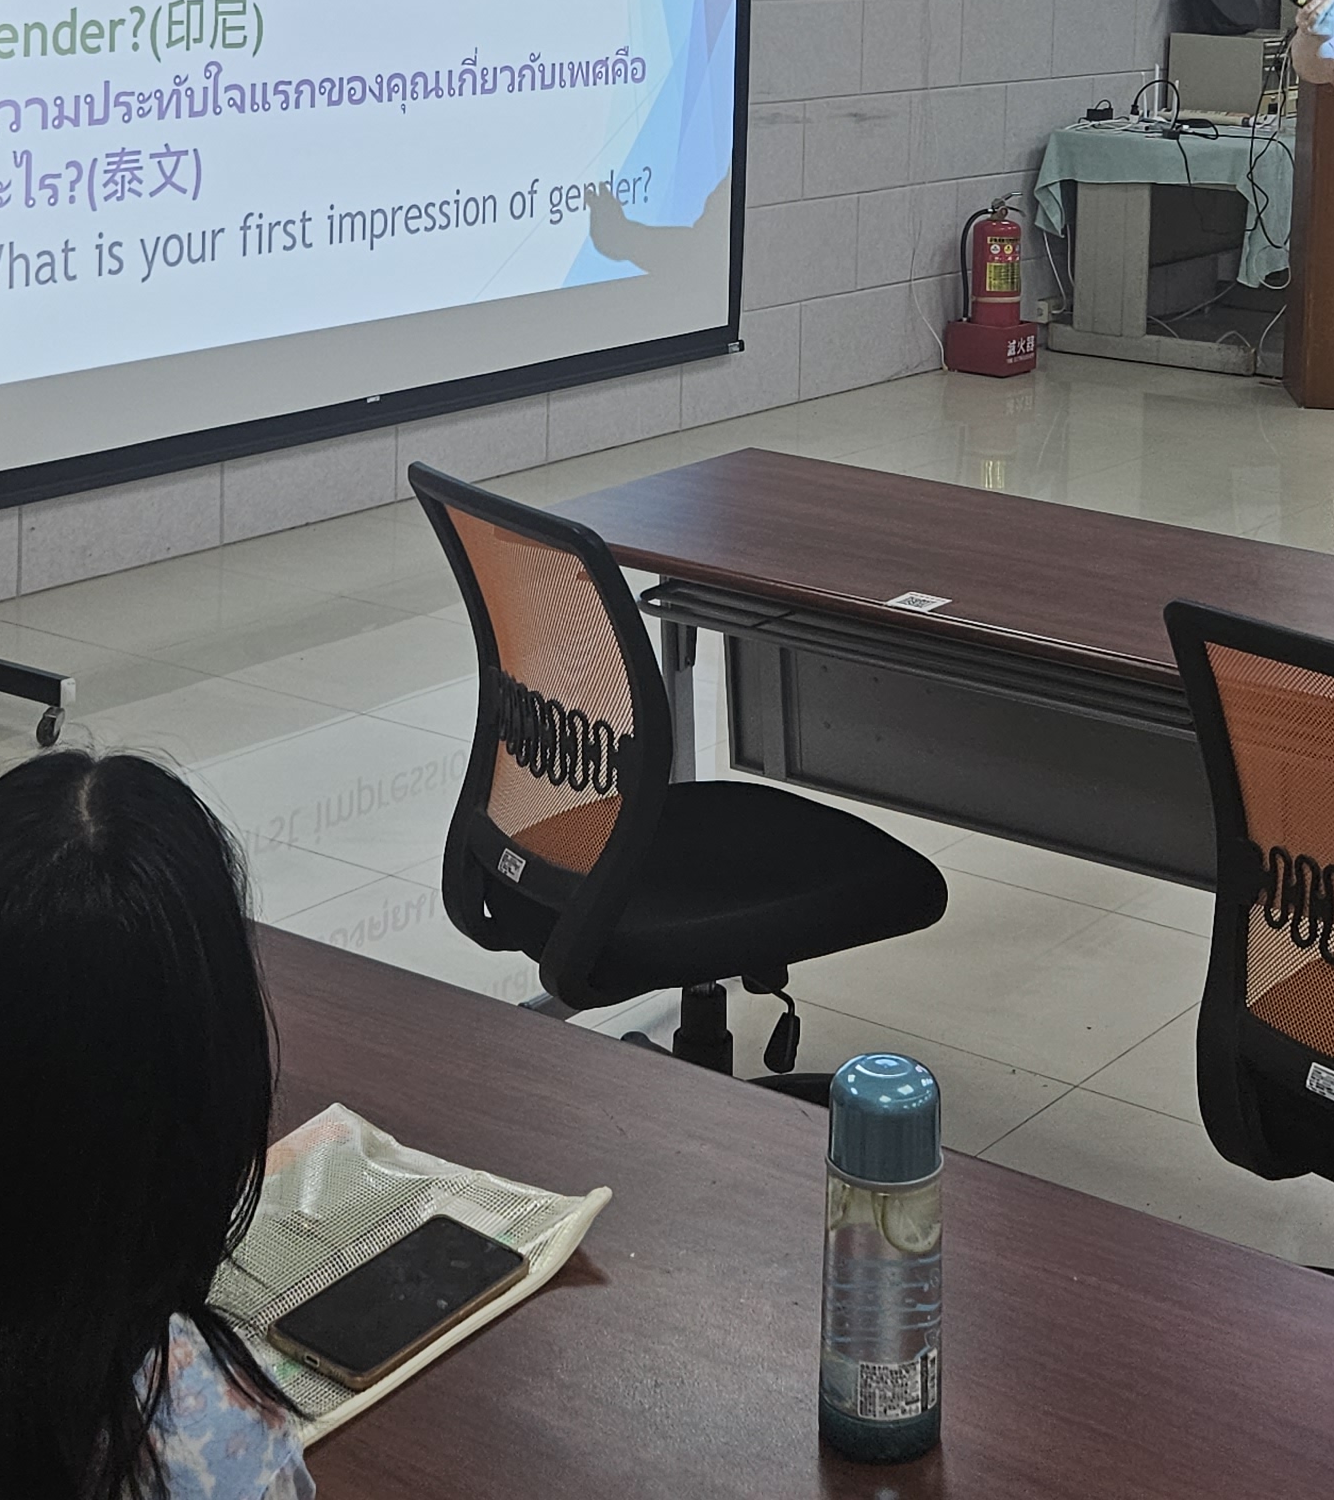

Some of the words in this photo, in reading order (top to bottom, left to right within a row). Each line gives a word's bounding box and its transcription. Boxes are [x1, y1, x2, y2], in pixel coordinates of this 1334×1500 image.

[95, 232, 126, 278] is
[140, 225, 226, 284] your
[239, 211, 313, 258] first
[327, 189, 498, 251] impression
[509, 178, 540, 221] of
[1007, 335, 1035, 357] 滅火器
